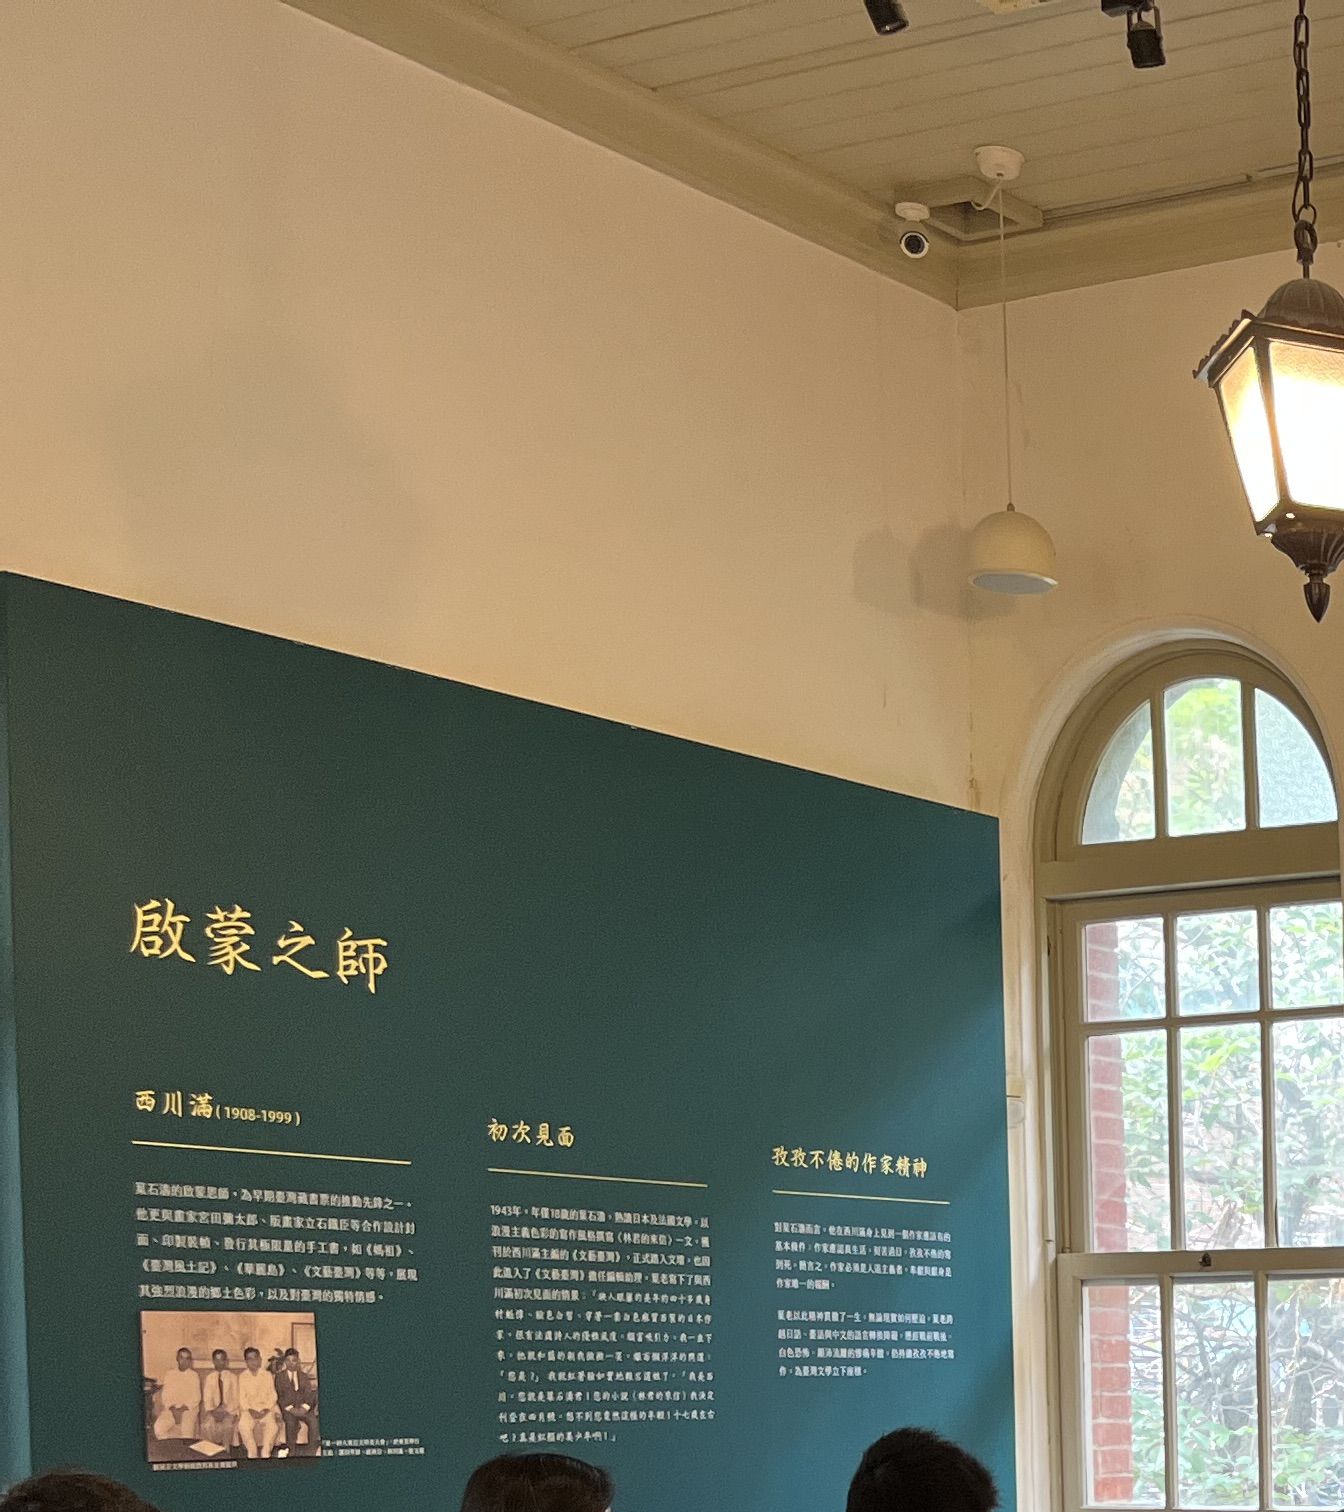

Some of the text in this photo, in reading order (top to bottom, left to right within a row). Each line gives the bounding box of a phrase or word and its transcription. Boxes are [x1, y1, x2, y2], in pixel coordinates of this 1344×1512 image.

[130, 897, 388, 994] 啟蒙之師
[135, 1090, 214, 1119] 西川滿
[487, 1117, 575, 1148] 初次見面
[771, 1146, 928, 1178] 孜孜不倦的作家精神
